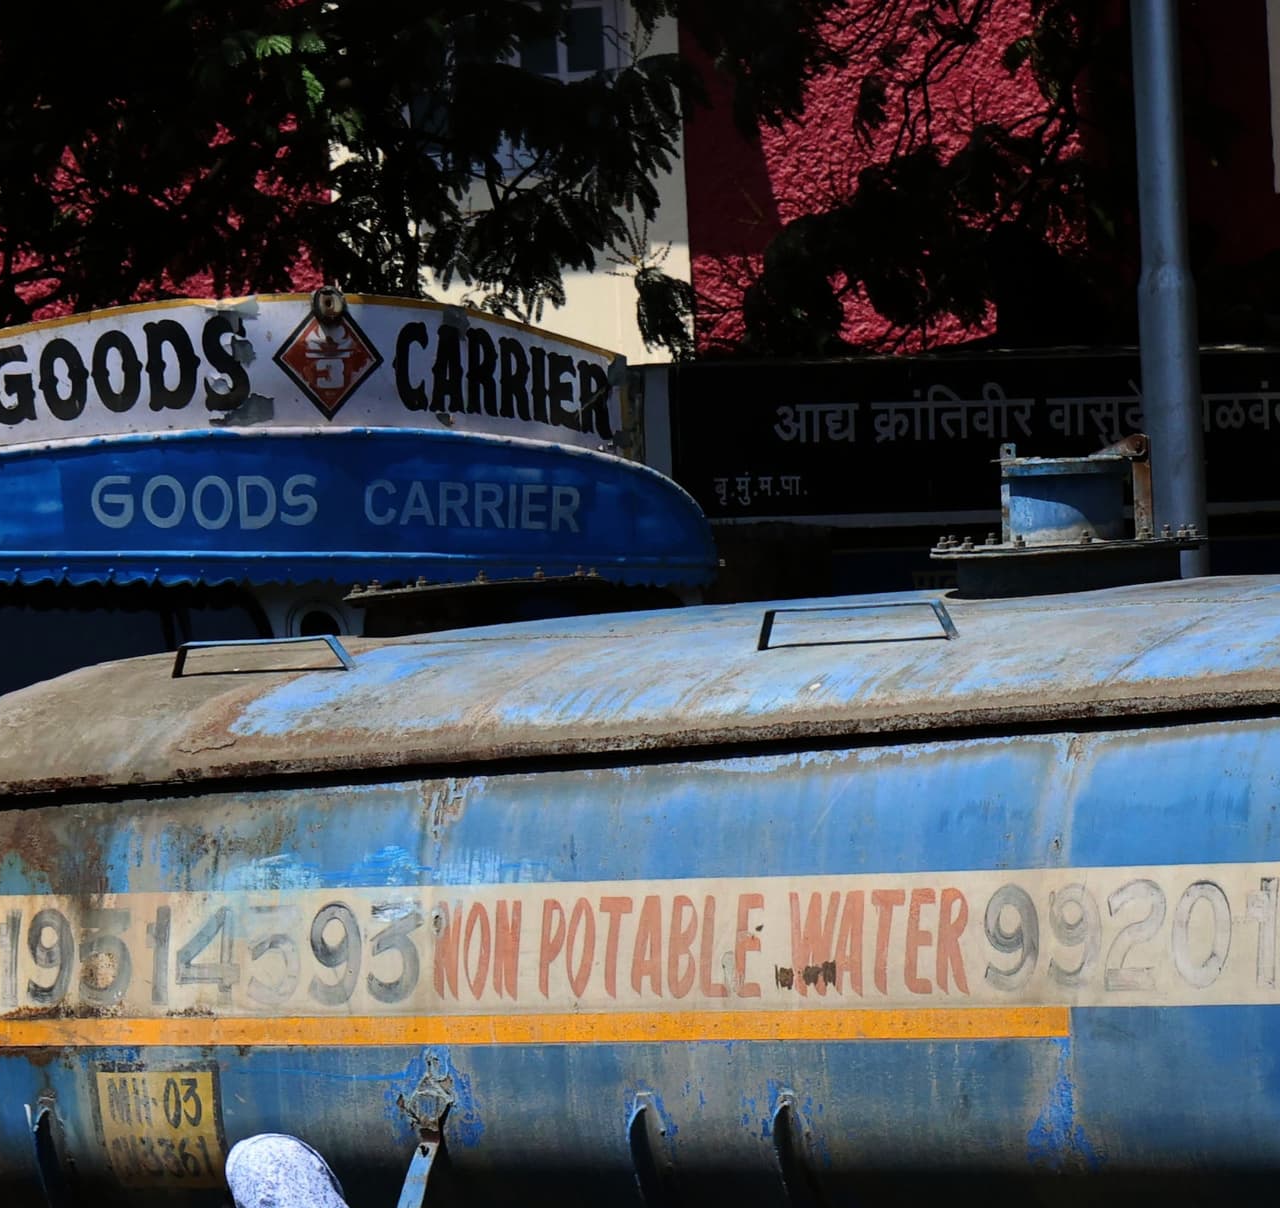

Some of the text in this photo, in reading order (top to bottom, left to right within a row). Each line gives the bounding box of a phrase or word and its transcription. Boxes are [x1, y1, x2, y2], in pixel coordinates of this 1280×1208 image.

[392, 319, 614, 440] CARRIER
[773, 401, 859, 443] आद्य
[871, 381, 1035, 442] क्रांतिवीर
[90, 474, 581, 532] GOODS CARRIER
[432, 899, 523, 1001] NON
[539, 892, 766, 1000] POTABLE
[789, 886, 971, 998] WATER
